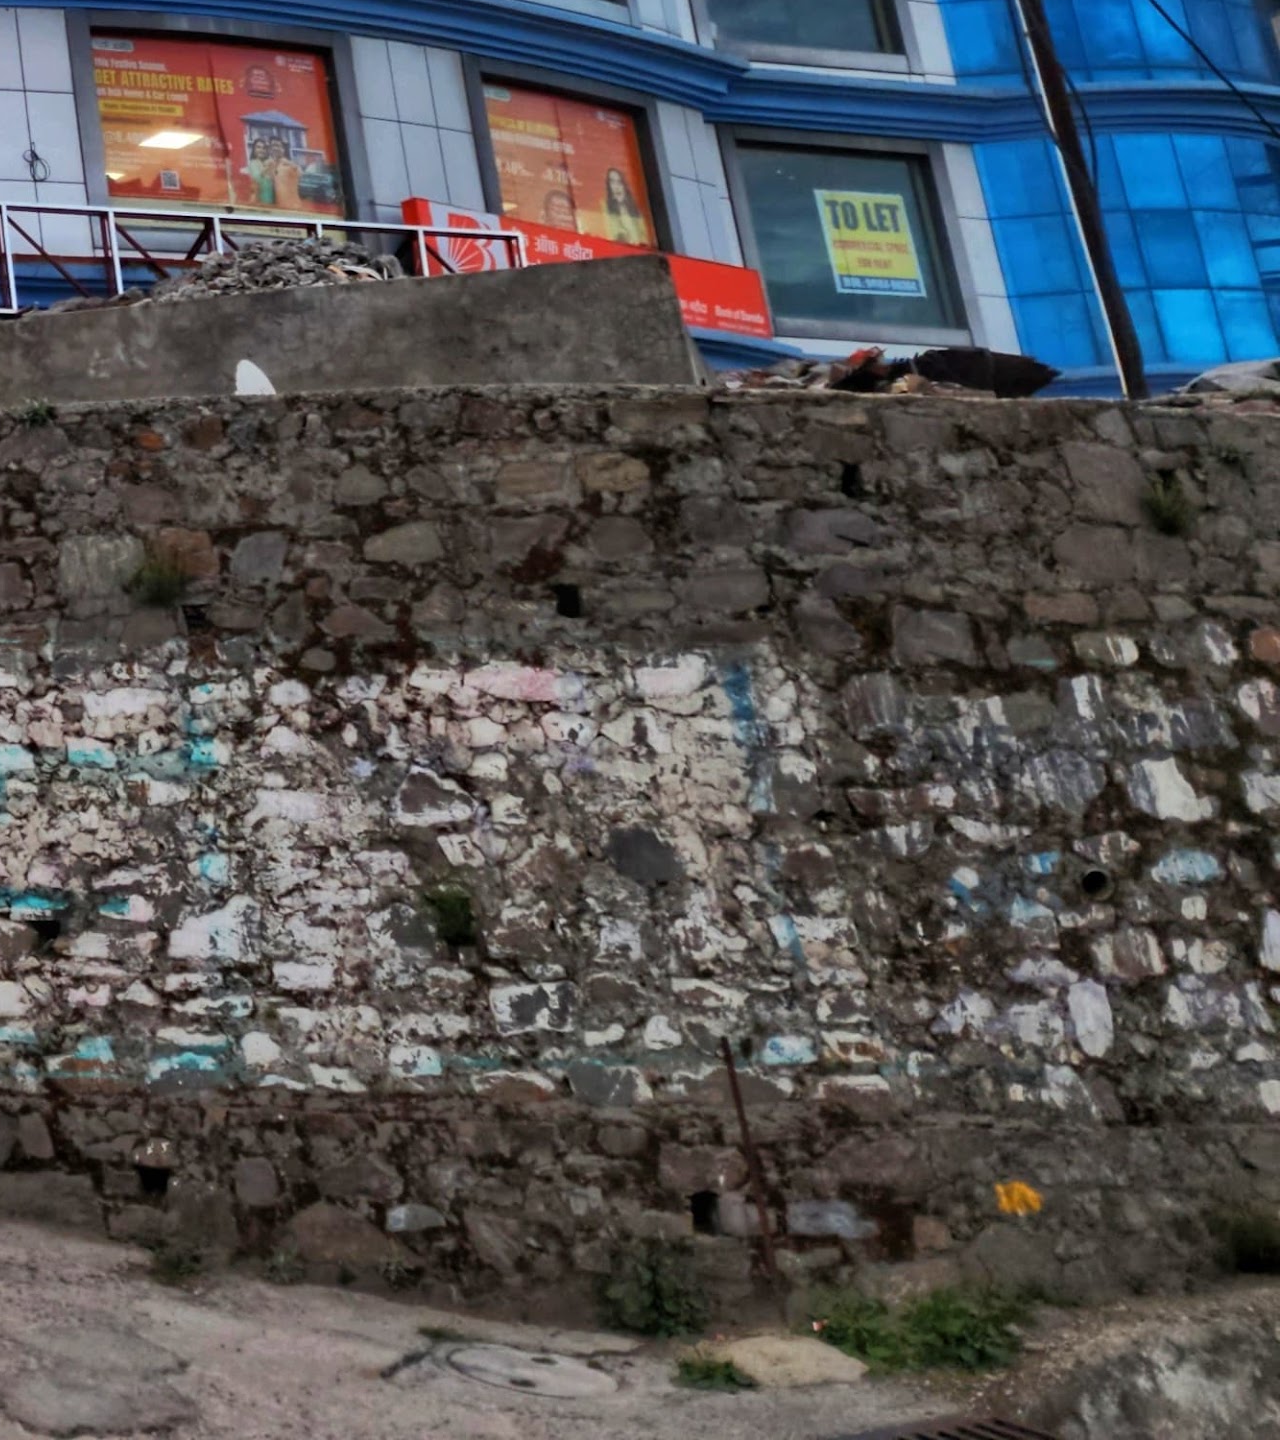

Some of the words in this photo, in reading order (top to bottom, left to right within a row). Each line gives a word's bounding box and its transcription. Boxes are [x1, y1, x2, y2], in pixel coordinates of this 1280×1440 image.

[94, 68, 115, 85] GET
[120, 69, 193, 91] ATTRACTIVE
[824, 199, 860, 231] TO
[861, 201, 901, 233] LET
